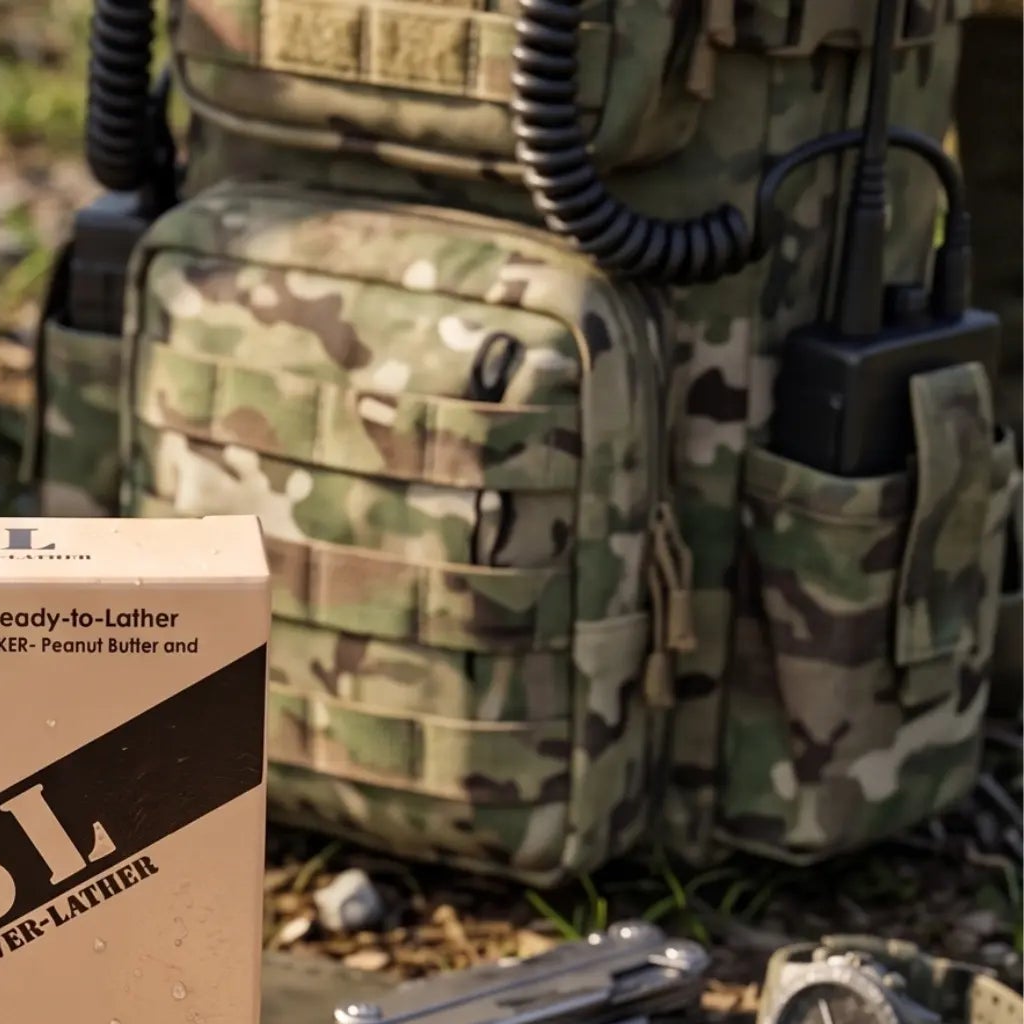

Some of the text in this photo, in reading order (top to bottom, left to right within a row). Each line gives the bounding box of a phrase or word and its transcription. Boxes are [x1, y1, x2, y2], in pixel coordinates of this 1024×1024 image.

[41, 637, 104, 654] Peanut
[108, 637, 159, 654] Butter
[163, 636, 199, 654] and
